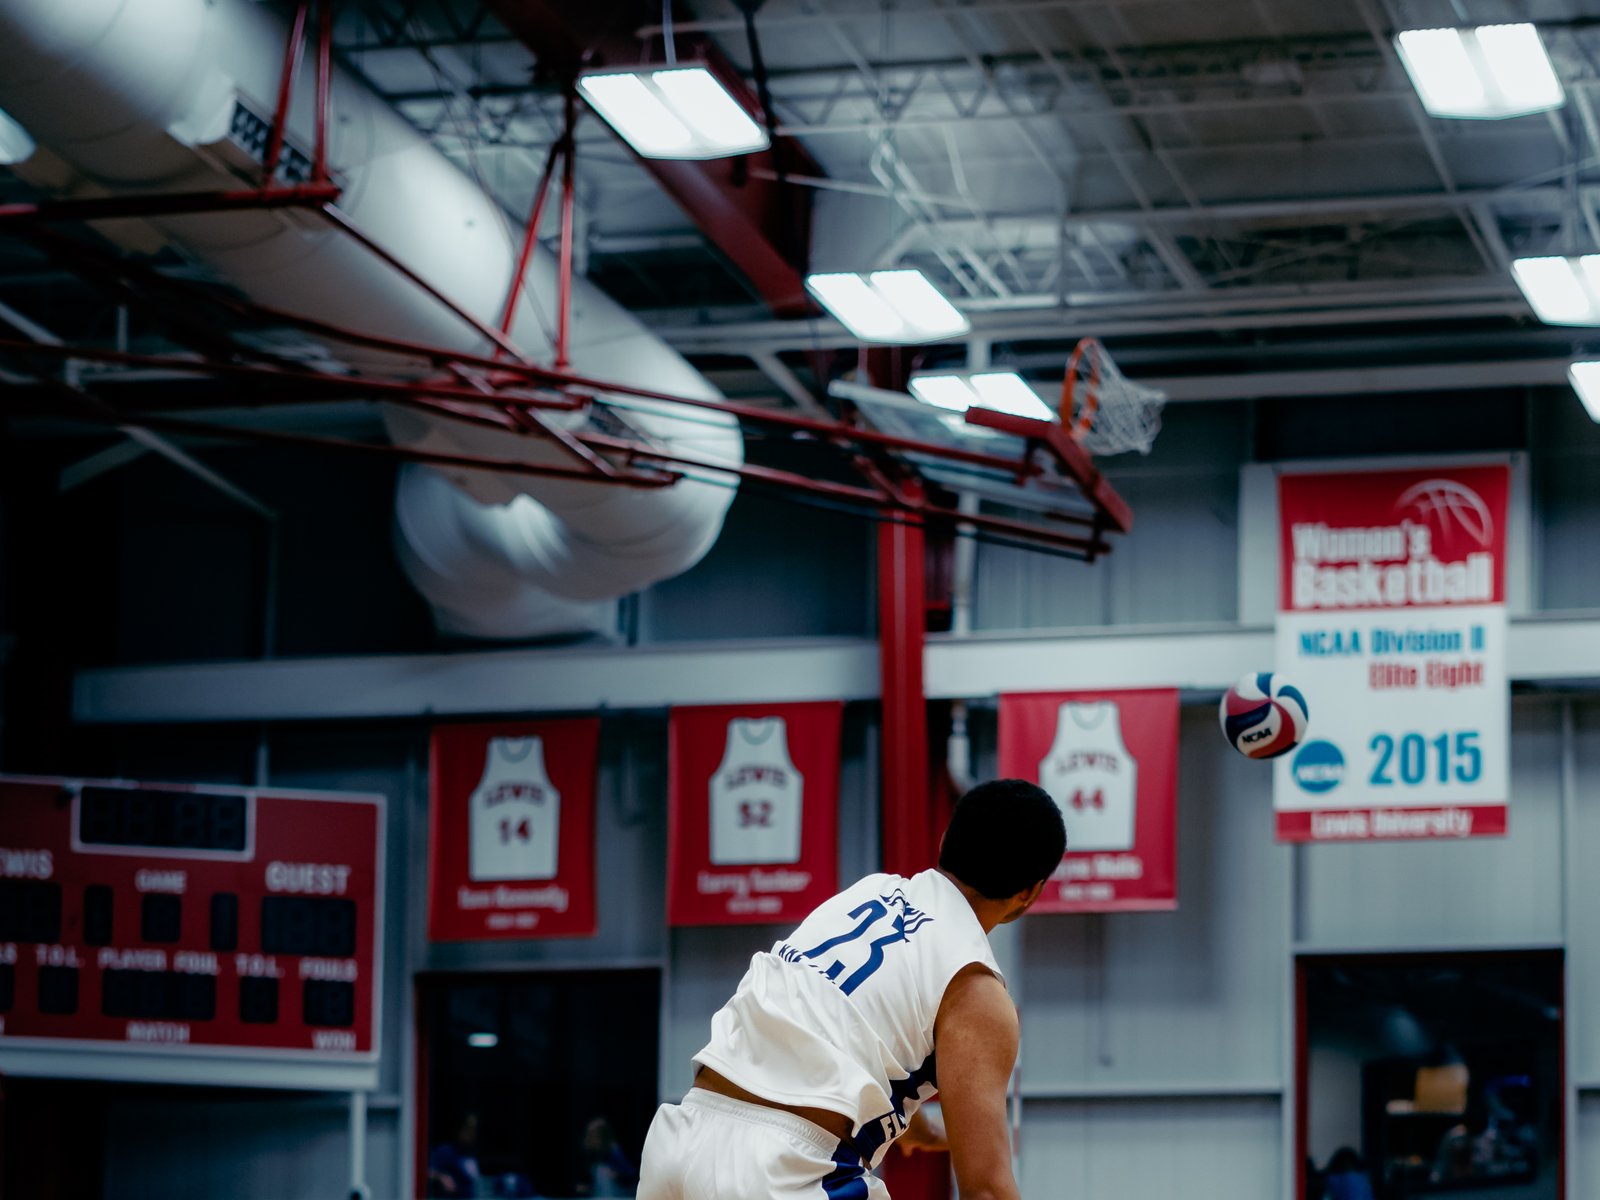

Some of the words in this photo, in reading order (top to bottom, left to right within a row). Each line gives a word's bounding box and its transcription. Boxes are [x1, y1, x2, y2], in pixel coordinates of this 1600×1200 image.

[1292, 519, 1431, 562] Women's
[1292, 552, 1494, 608] Basketball
[1298, 631, 1361, 657] NCAA
[1371, 626, 1461, 654] Division
[1369, 662, 1418, 690] Elite
[1427, 661, 1485, 691] Eight
[1242, 728, 1272, 744] NCAA
[1056, 752, 1119, 776] LEWIS
[1369, 731, 1482, 786] 2015
[725, 764, 788, 791] LEWIS
[483, 780, 546, 808] LEWIS
[1070, 788, 1105, 814] 44
[497, 816, 532, 845] 14
[1310, 811, 1368, 838] Lewis
[1373, 806, 1474, 837] University
[265, 861, 351, 895] GUEST
